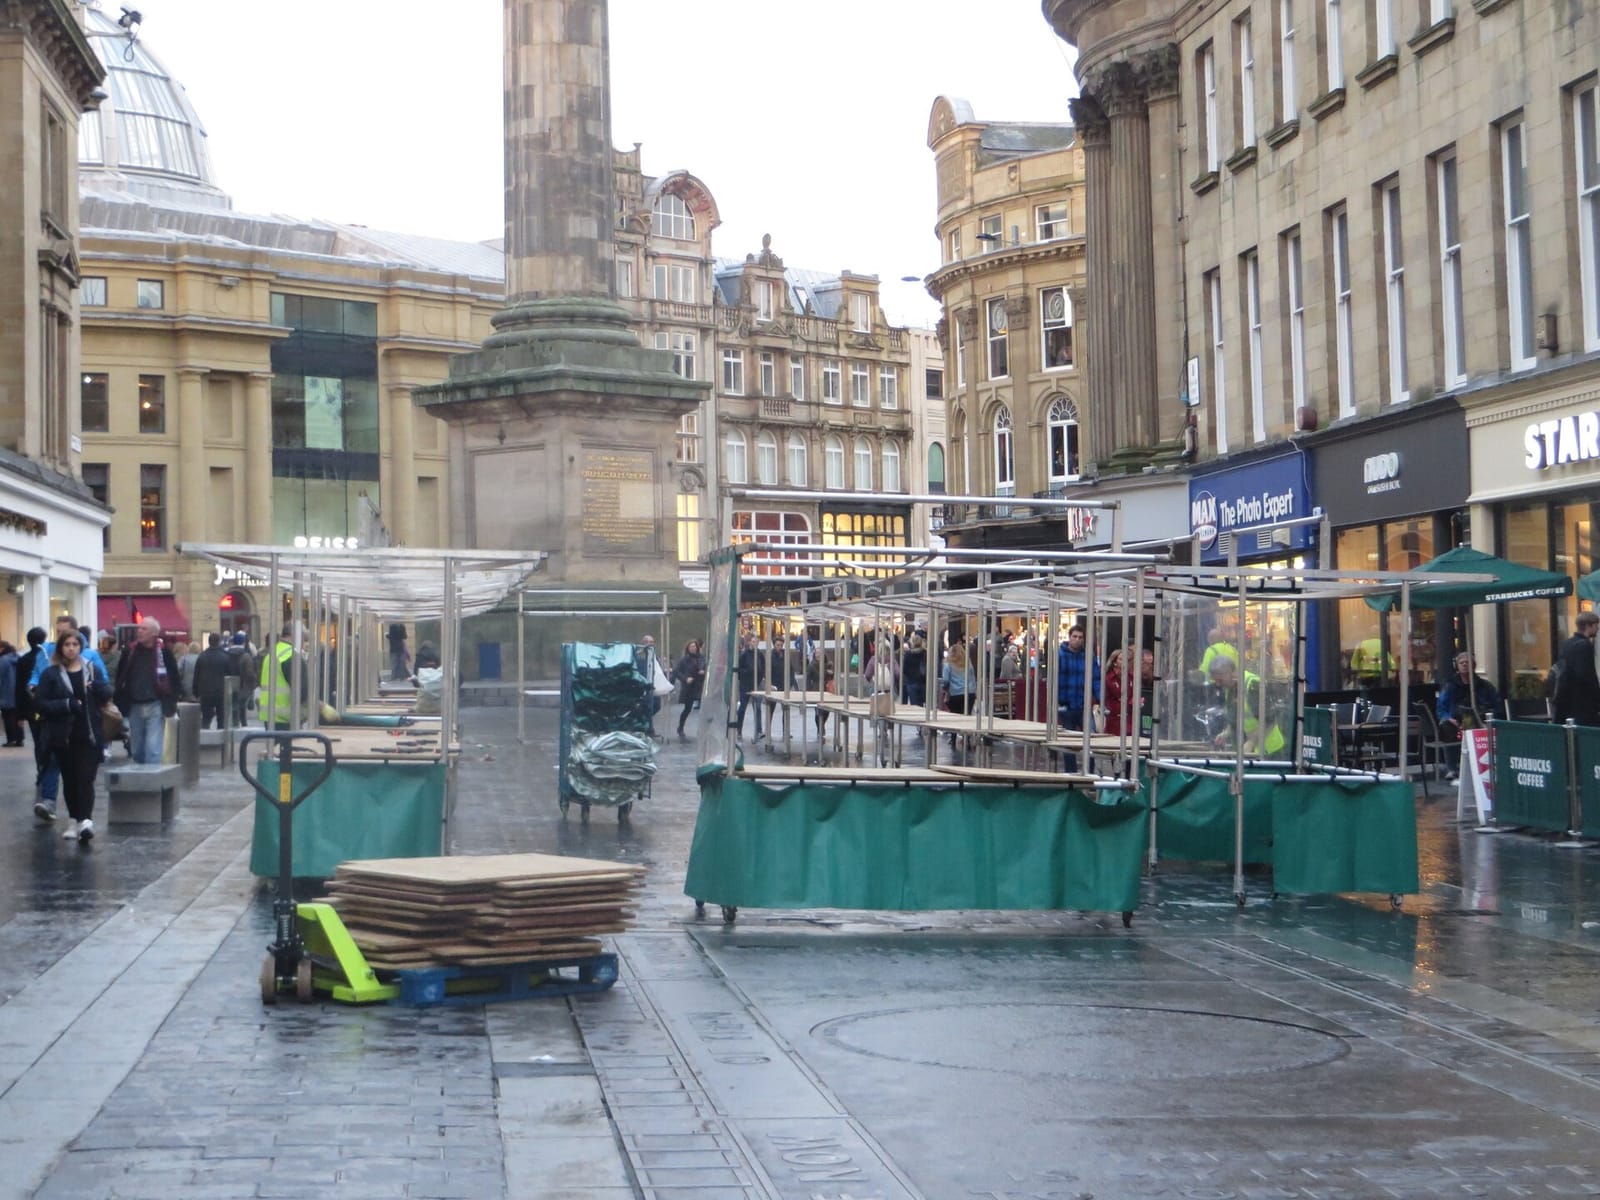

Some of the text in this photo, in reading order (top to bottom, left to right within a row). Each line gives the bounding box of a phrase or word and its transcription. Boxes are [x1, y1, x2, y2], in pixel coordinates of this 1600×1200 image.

[1192, 496, 1217, 526] MAX
[1220, 487, 1294, 527] The Photo Expert
[1485, 587, 1565, 601] STARBUCKS COFFEE
[1510, 757, 1551, 773] STARBUCKS
[1517, 773, 1544, 788] COFFEE
